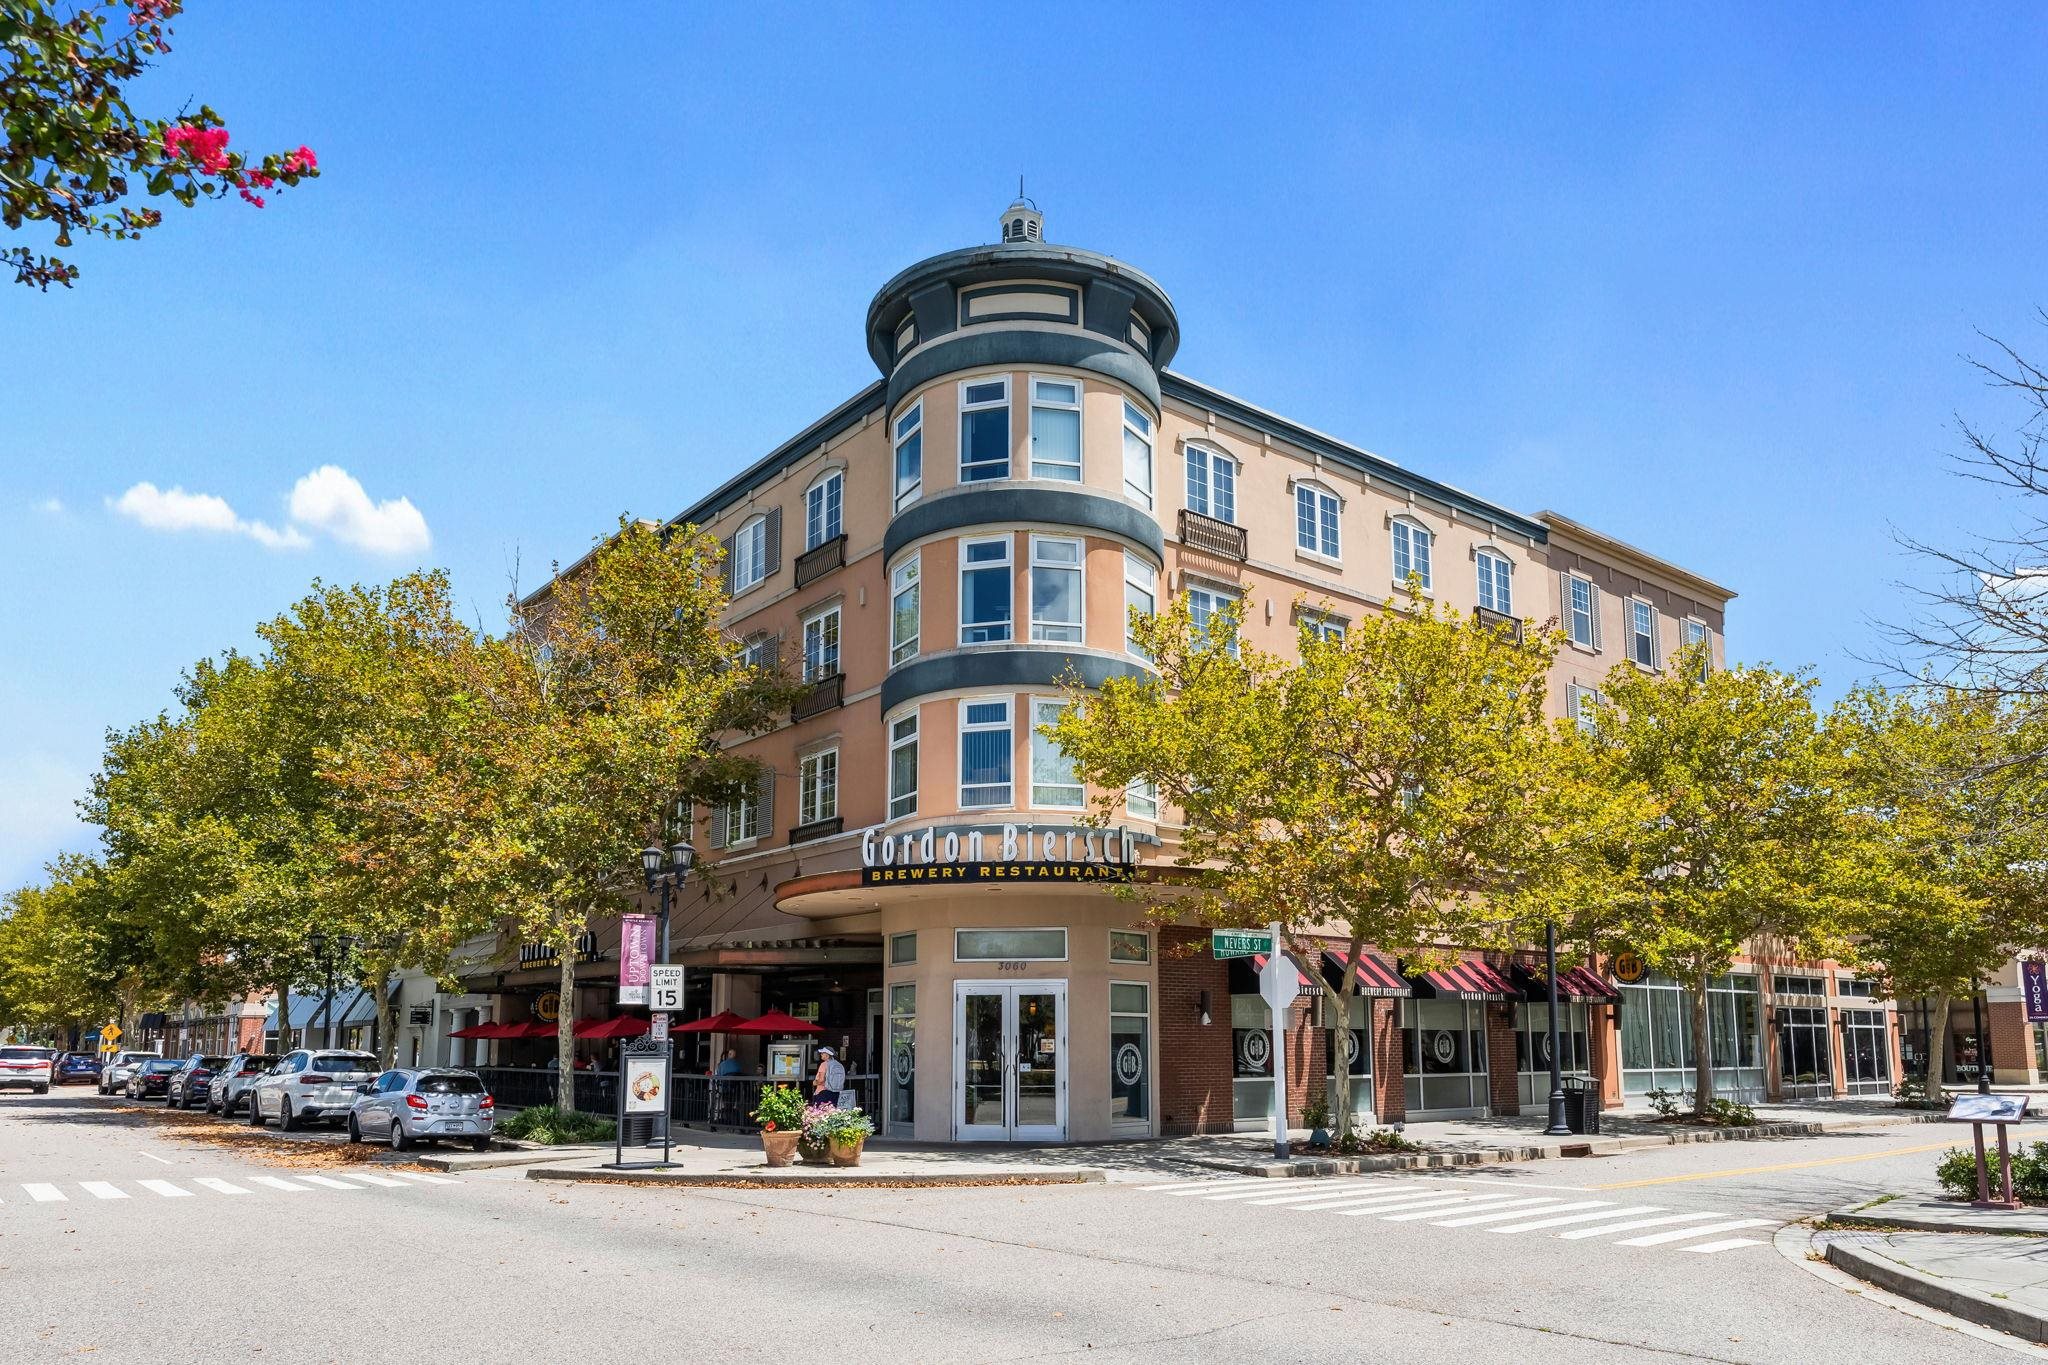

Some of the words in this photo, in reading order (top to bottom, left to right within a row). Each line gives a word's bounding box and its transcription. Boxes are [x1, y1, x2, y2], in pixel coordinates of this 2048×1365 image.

[862, 826, 983, 867] Gordon
[1002, 822, 1135, 864] Biersch
[872, 867, 966, 881] BREWERY
[980, 866, 1123, 877] RESTAURANT
[1224, 937, 1251, 950] NEVERS
[1253, 939, 1262, 951] ST
[628, 926, 641, 983] UPTOWN
[653, 969, 681, 977] SPEED
[998, 961, 1027, 971] 3060
[655, 978, 678, 986] LIMIT
[657, 990, 677, 1006] 15
[1361, 986, 1382, 996] BREWERY
[1383, 987, 1411, 997] RESTAURANT
[2030, 975, 2043, 1012] Yoga
[1956, 1064, 1993, 1072] BOUTIE
